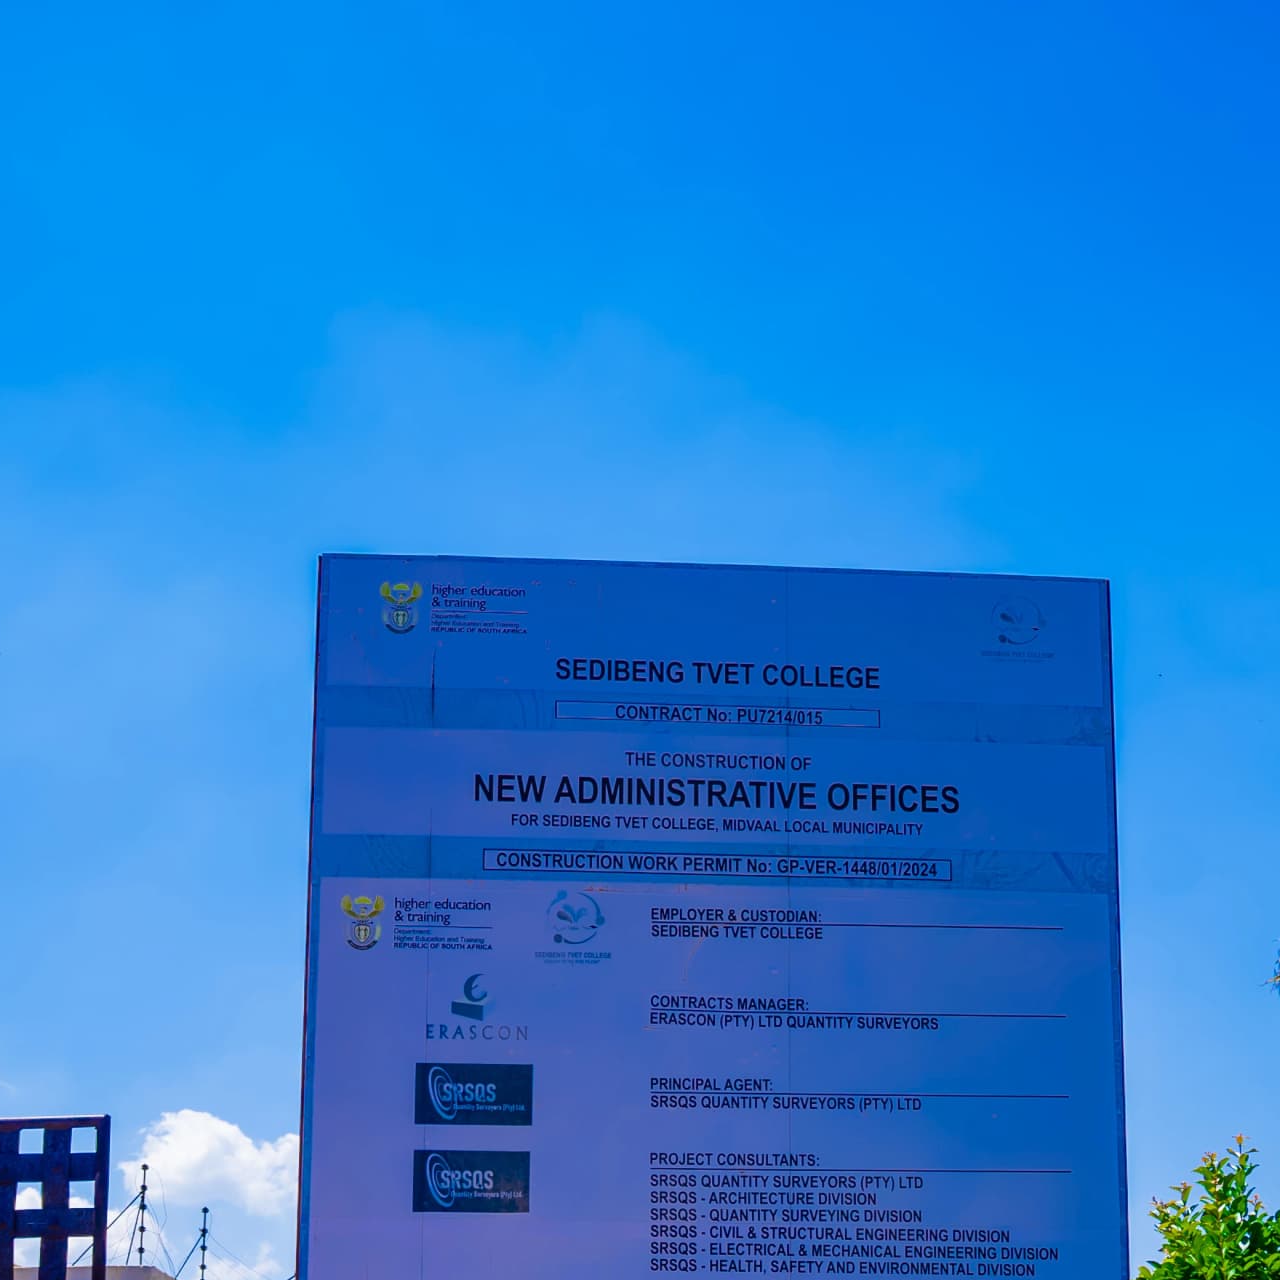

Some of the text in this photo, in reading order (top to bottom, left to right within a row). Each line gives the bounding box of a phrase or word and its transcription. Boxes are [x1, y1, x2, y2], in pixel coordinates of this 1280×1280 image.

[431, 583, 526, 599] higher education
[431, 596, 487, 612] & training
[555, 658, 880, 689] SEDIBENG TVET COLLEGE
[615, 704, 824, 726] CONTRACT No: PU7214/015
[624, 751, 812, 771] THE CONSTRUCTION OF
[474, 774, 960, 814] NEW ADMINISTRATIVE OFFICES
[511, 813, 923, 836] FOR SEDIBENG TVET COLLEGE, MIDVAAL LOCAL MUNICIPALITY
[496, 853, 938, 877] CONSTRUCTION WORK PERMIT No: GP-VER-1448/01/2024
[394, 896, 492, 913] higher education
[394, 910, 451, 926] & training
[650, 907, 823, 924] EMPLOYER & CUSTODIAN:
[651, 924, 823, 940] SEDIBENG TVET COLLEGE
[393, 941, 429, 949] REPUBLIC
[429, 942, 440, 950] OF
[466, 942, 493, 951] AFRICA
[650, 994, 809, 1011] CONTRACTS MANAGER:
[649, 1011, 939, 1030] ERASCON (PTY) LTD QUANTITY SURVEYORS
[425, 1023, 528, 1041] ERASCON
[442, 1083, 497, 1102] SRSQS
[650, 1077, 773, 1093] PRINCIPAL AGENT:
[650, 1094, 922, 1113] SRSQS QUANTITY SURVEYORS (PTY) LTD
[649, 1152, 820, 1167] PROJECT CONSULTANTS:
[440, 1170, 494, 1190] SRSQS
[650, 1174, 924, 1191] SRSQS QUANTITY SURVEYORS (PTY) LTD
[650, 1190, 697, 1205] SRSQS
[708, 1191, 814, 1206] ARCHITECTURE
[818, 1192, 877, 1206] DIVISION
[650, 1207, 697, 1222] SRSQS
[709, 1208, 778, 1222] QUANTITY
[781, 1208, 860, 1223] SURVEYING
[864, 1209, 922, 1223] DIVISION
[650, 1224, 698, 1239] SRSQS
[709, 1225, 744, 1239] CIVIL
[747, 1226, 757, 1240] &
[760, 1226, 853, 1241] STRUCTURAL
[855, 1227, 949, 1242] ENGINEERING
[952, 1229, 1010, 1243] DIVISION
[650, 1241, 698, 1256] SRSQS
[709, 1242, 795, 1257] ELECTRICAL
[798, 1243, 808, 1257] &
[811, 1244, 901, 1258] MECHANICAL
[904, 1245, 997, 1260] ENGINEERING
[1001, 1247, 1058, 1260] DIVISION
[650, 1257, 697, 1273] SRSQS
[709, 1259, 767, 1274] HEALTH,
[770, 1259, 824, 1274] SAFETY
[826, 1260, 856, 1274] AND
[859, 1261, 974, 1276] ENVIRONMENTAL
[977, 1263, 1035, 1277] DIVISION
